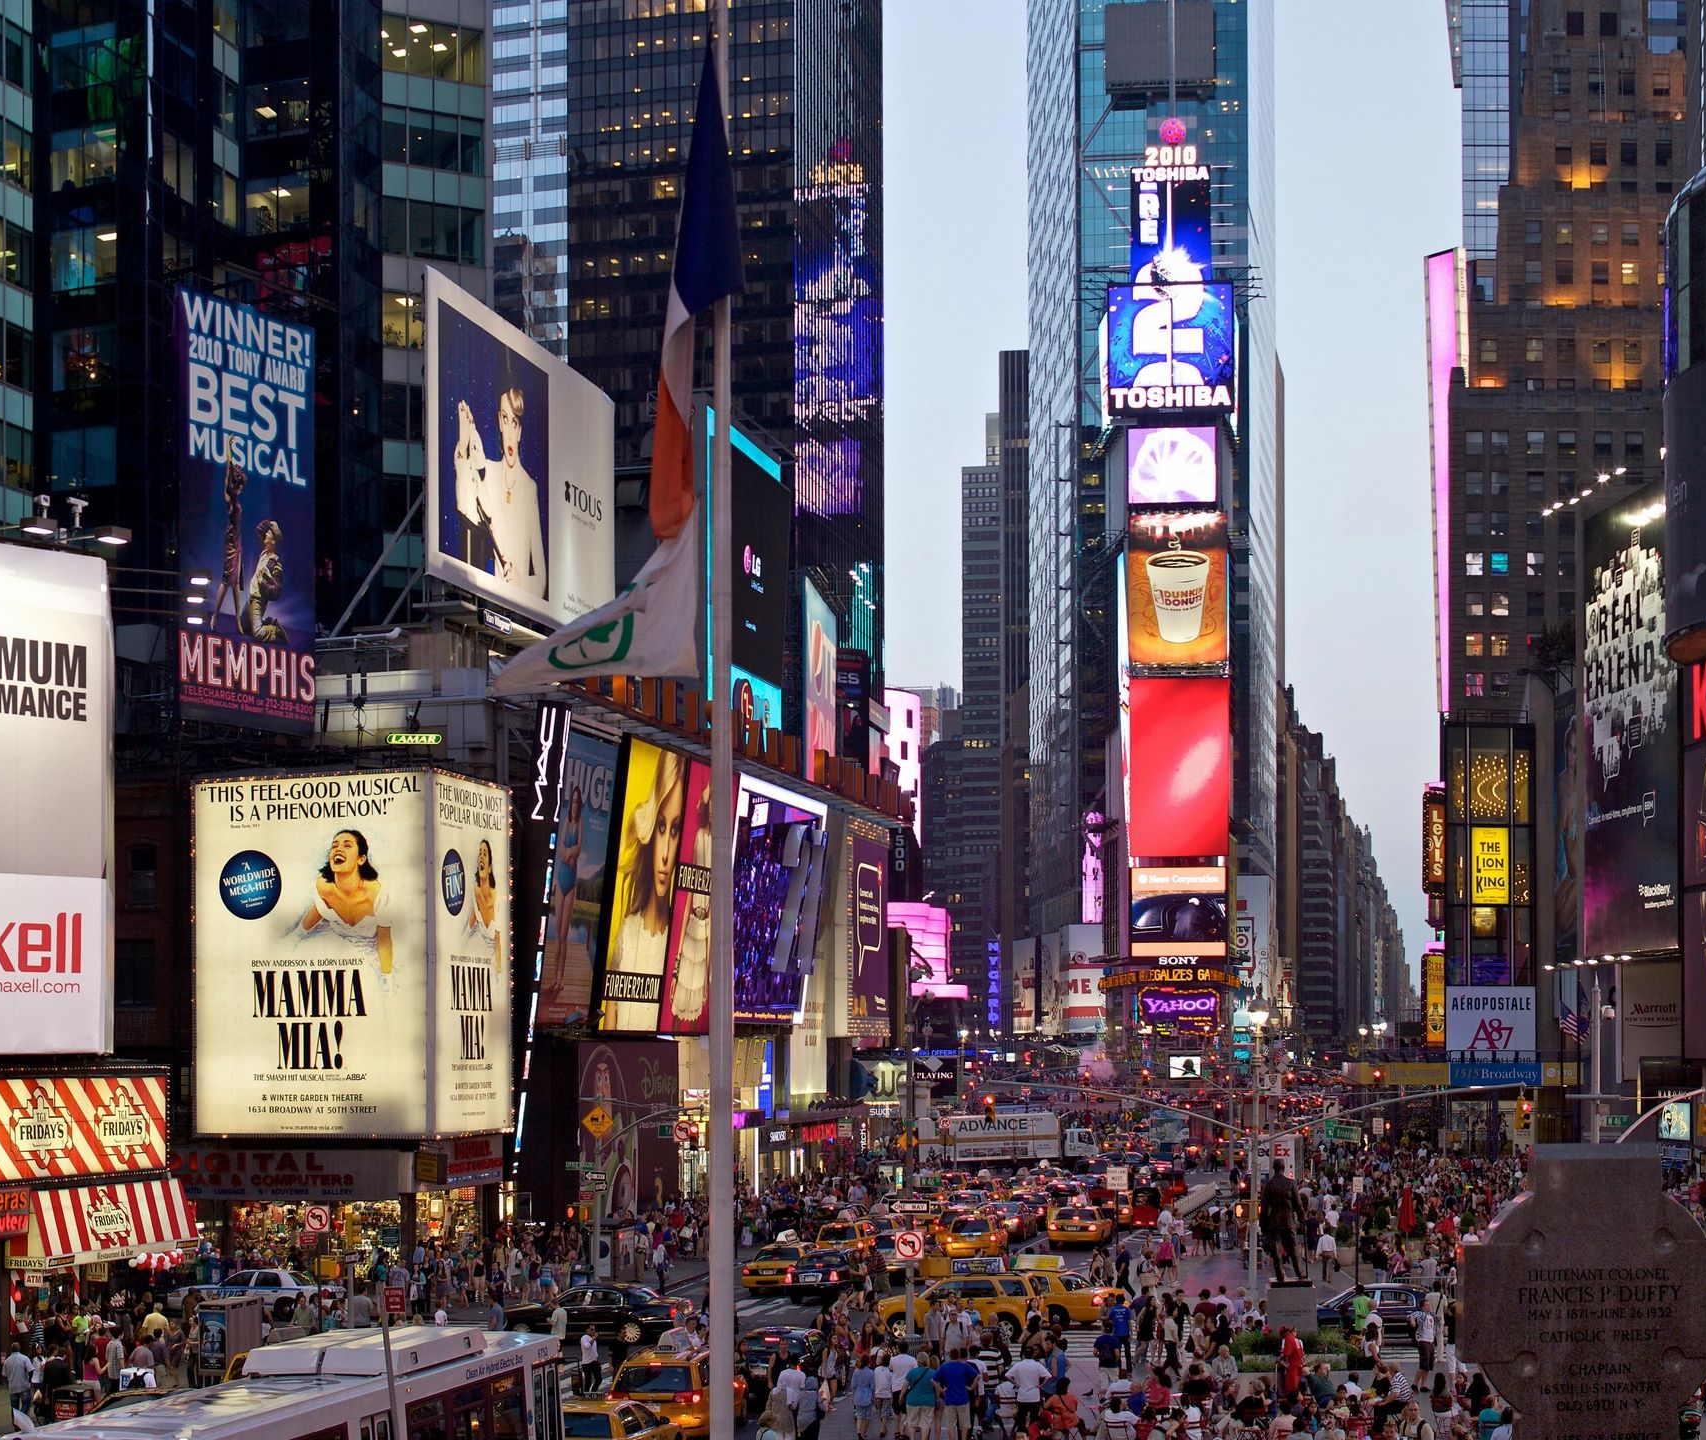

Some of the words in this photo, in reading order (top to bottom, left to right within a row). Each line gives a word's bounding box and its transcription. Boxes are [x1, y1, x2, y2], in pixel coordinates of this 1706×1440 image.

[1144, 145, 1197, 167] 2010
[1130, 165, 1211, 183] TOSHIBA
[181, 290, 311, 368] WINNER!
[188, 333, 223, 366] 2010
[227, 344, 261, 378] TONY
[264, 357, 306, 393] AWARD
[189, 361, 306, 450] BEST
[1110, 385, 1232, 410] TOSHIBA
[189, 423, 307, 487] MUSICAL
[572, 484, 603, 523] TOUS
[1598, 588, 1644, 647] REAL
[179, 631, 316, 703] MEMPHIS
[183, 684, 256, 705] TELECHARGE.COM
[265, 697, 314, 714] 212-239-6200
[387, 733, 441, 746] LAMAR
[251, 780, 341, 802] FEEL-GOOD
[347, 774, 421, 799] MUSICAL
[565, 757, 614, 812] HUGE
[439, 802, 471, 825] POPULAR
[1475, 855, 1505, 875] LION
[222, 866, 277, 888] WORLDWIDE
[1148, 875, 1170, 884] News
[1172, 874, 1219, 885] Corporation
[1475, 875, 1506, 895] KING
[271, 958, 308, 967] ANDERSSON
[1158, 956, 1199, 965] SONY
[252, 968, 367, 1018] MAMMA
[450, 964, 493, 1012] MAMMA
[604, 972, 661, 1001] FOREVER21.COM
[1143, 996, 1216, 1014] YAHOO!
[1451, 992, 1532, 1011] AÉROPOSTALE
[1629, 1002, 1677, 1016] Marriott
[276, 1019, 344, 1071] MIA!
[459, 1014, 486, 1060] MIA!
[299, 1073, 325, 1082] MUSICAL
[916, 1071, 954, 1080] PLAYING
[1454, 1067, 1481, 1080] 1515
[1480, 1067, 1539, 1082] Broadway
[269, 1093, 298, 1103] WINTER
[300, 1093, 330, 1103] GARDEN
[331, 1093, 364, 1103] THEATRE
[247, 1105, 267, 1115] 1634
[269, 1105, 313, 1115] BROADWAY
[326, 1105, 347, 1114] 50TH
[349, 1104, 378, 1114] STREET
[19, 1121, 65, 1141] FRIDAY'S
[102, 1118, 143, 1138] FRIDAY'S
[958, 1118, 1029, 1132] ADVANCE
[251, 1173, 355, 1188] COMPUTERS
[894, 1203, 907, 1211] ONE
[911, 1203, 925, 1211] WAY
[94, 1212, 125, 1228] FRIDAY'S
[26, 1274, 43, 1284] ATM
[1527, 1267, 1604, 1282] LIEUTENANT
[1608, 1267, 1670, 1281] COLONEL
[1517, 1286, 1595, 1305] FRANCIS
[1618, 1284, 1683, 1302] DUFFY
[1539, 1330, 1606, 1344] CATHOLIC
[1613, 1328, 1661, 1342] PRIEST
[1568, 1362, 1632, 1376] CHAPLAIN
